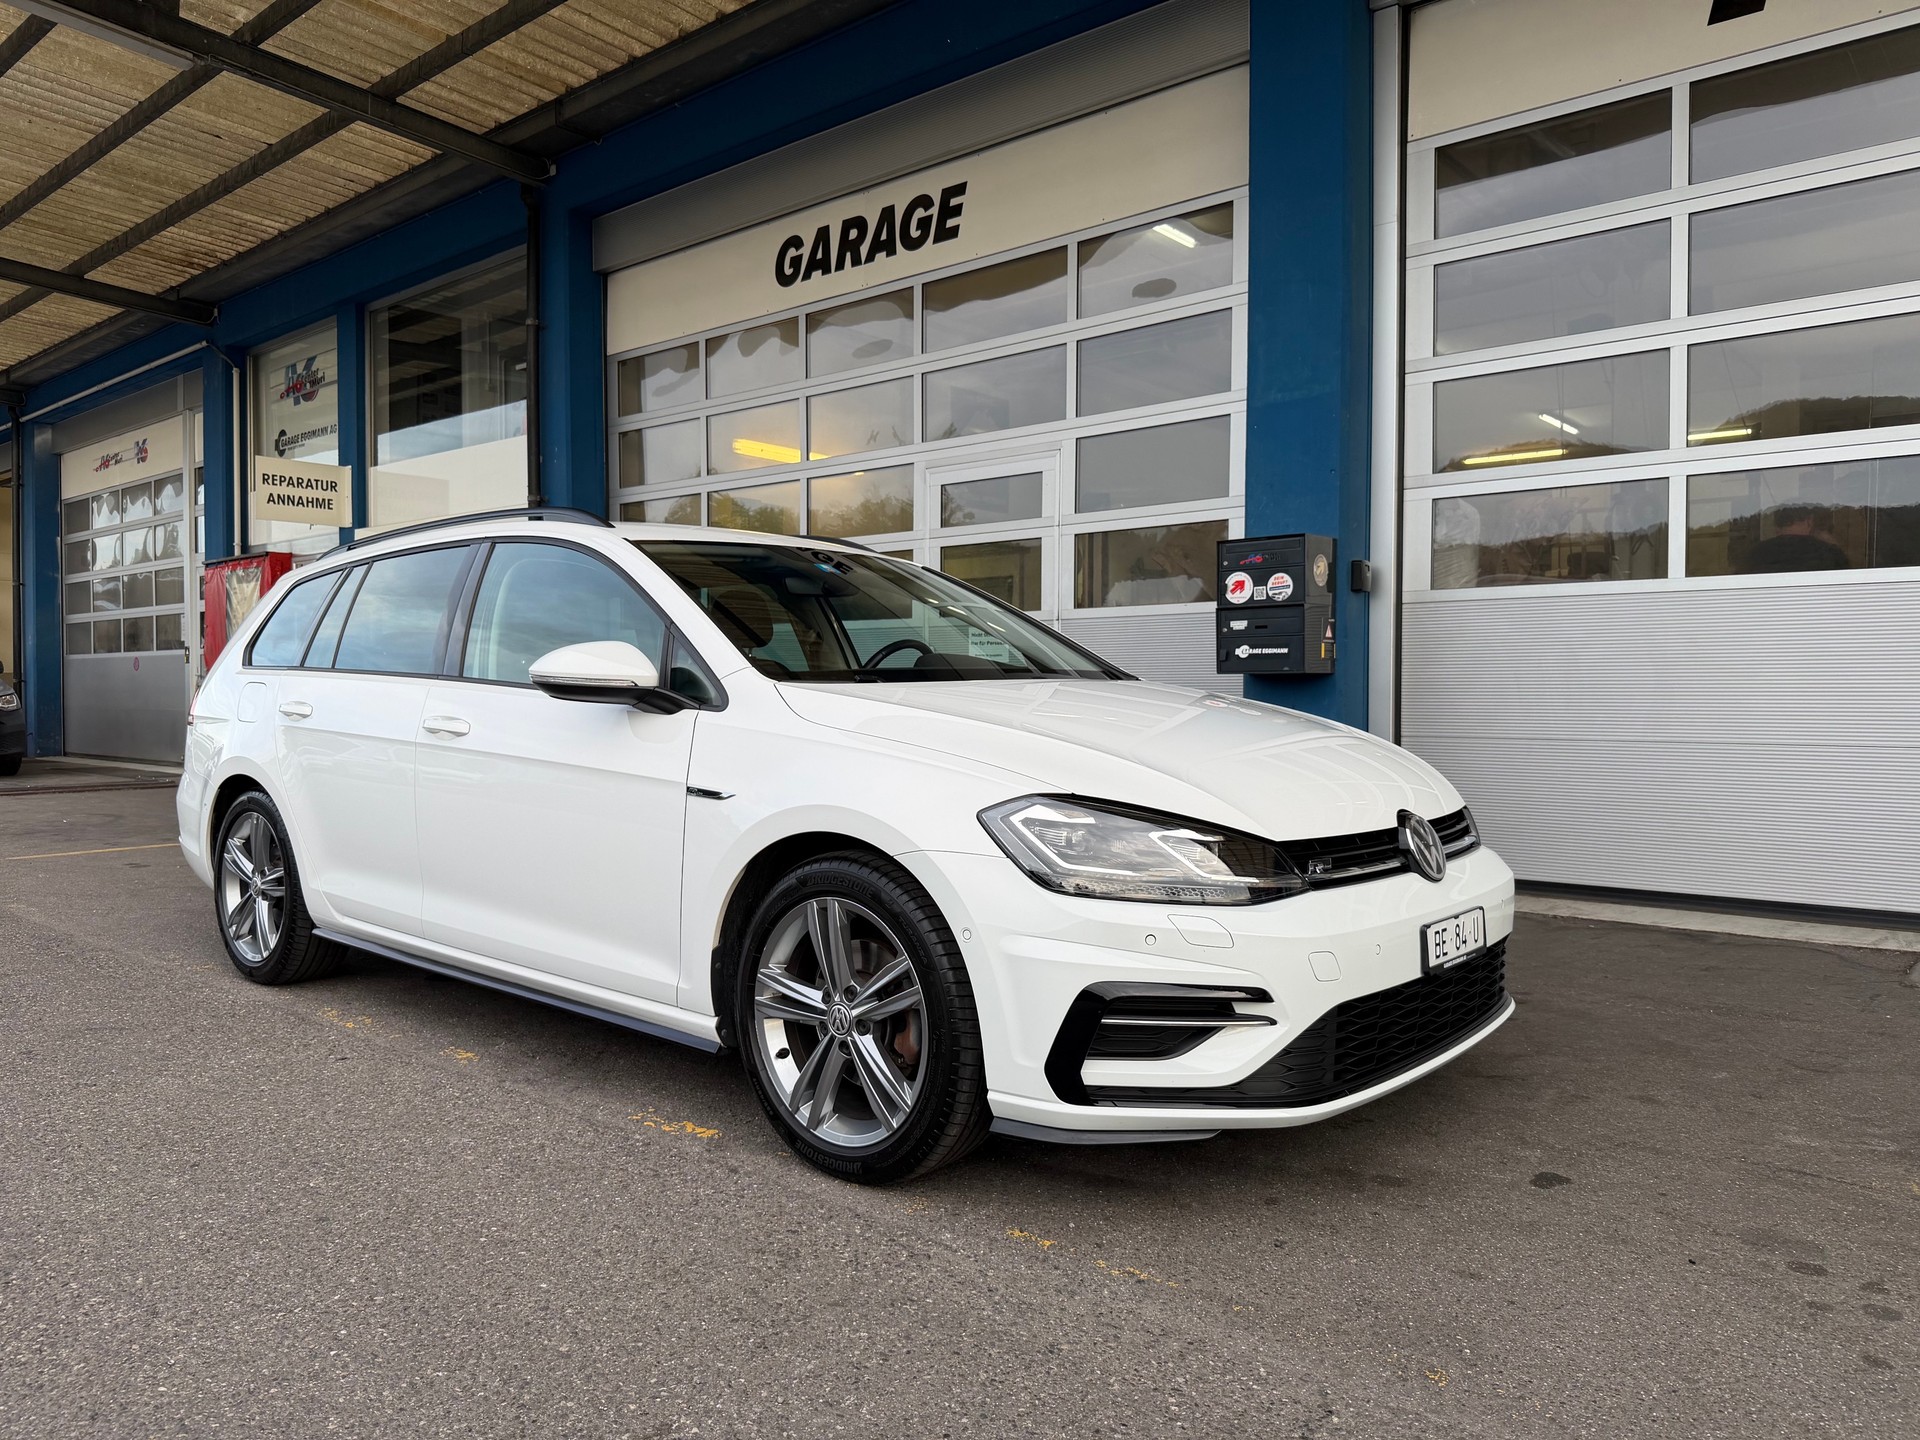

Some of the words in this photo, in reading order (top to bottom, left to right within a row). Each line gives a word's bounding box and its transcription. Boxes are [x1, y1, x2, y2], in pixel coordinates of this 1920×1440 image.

[775, 181, 968, 288] GARAGE
[281, 433, 300, 448] GARAGE
[262, 473, 338, 493] REPARATUR
[266, 492, 334, 511] ANNAHME
[806, 873, 876, 898] BRIDGESTONE
[794, 1139, 863, 1175] BRIDGESTONE
